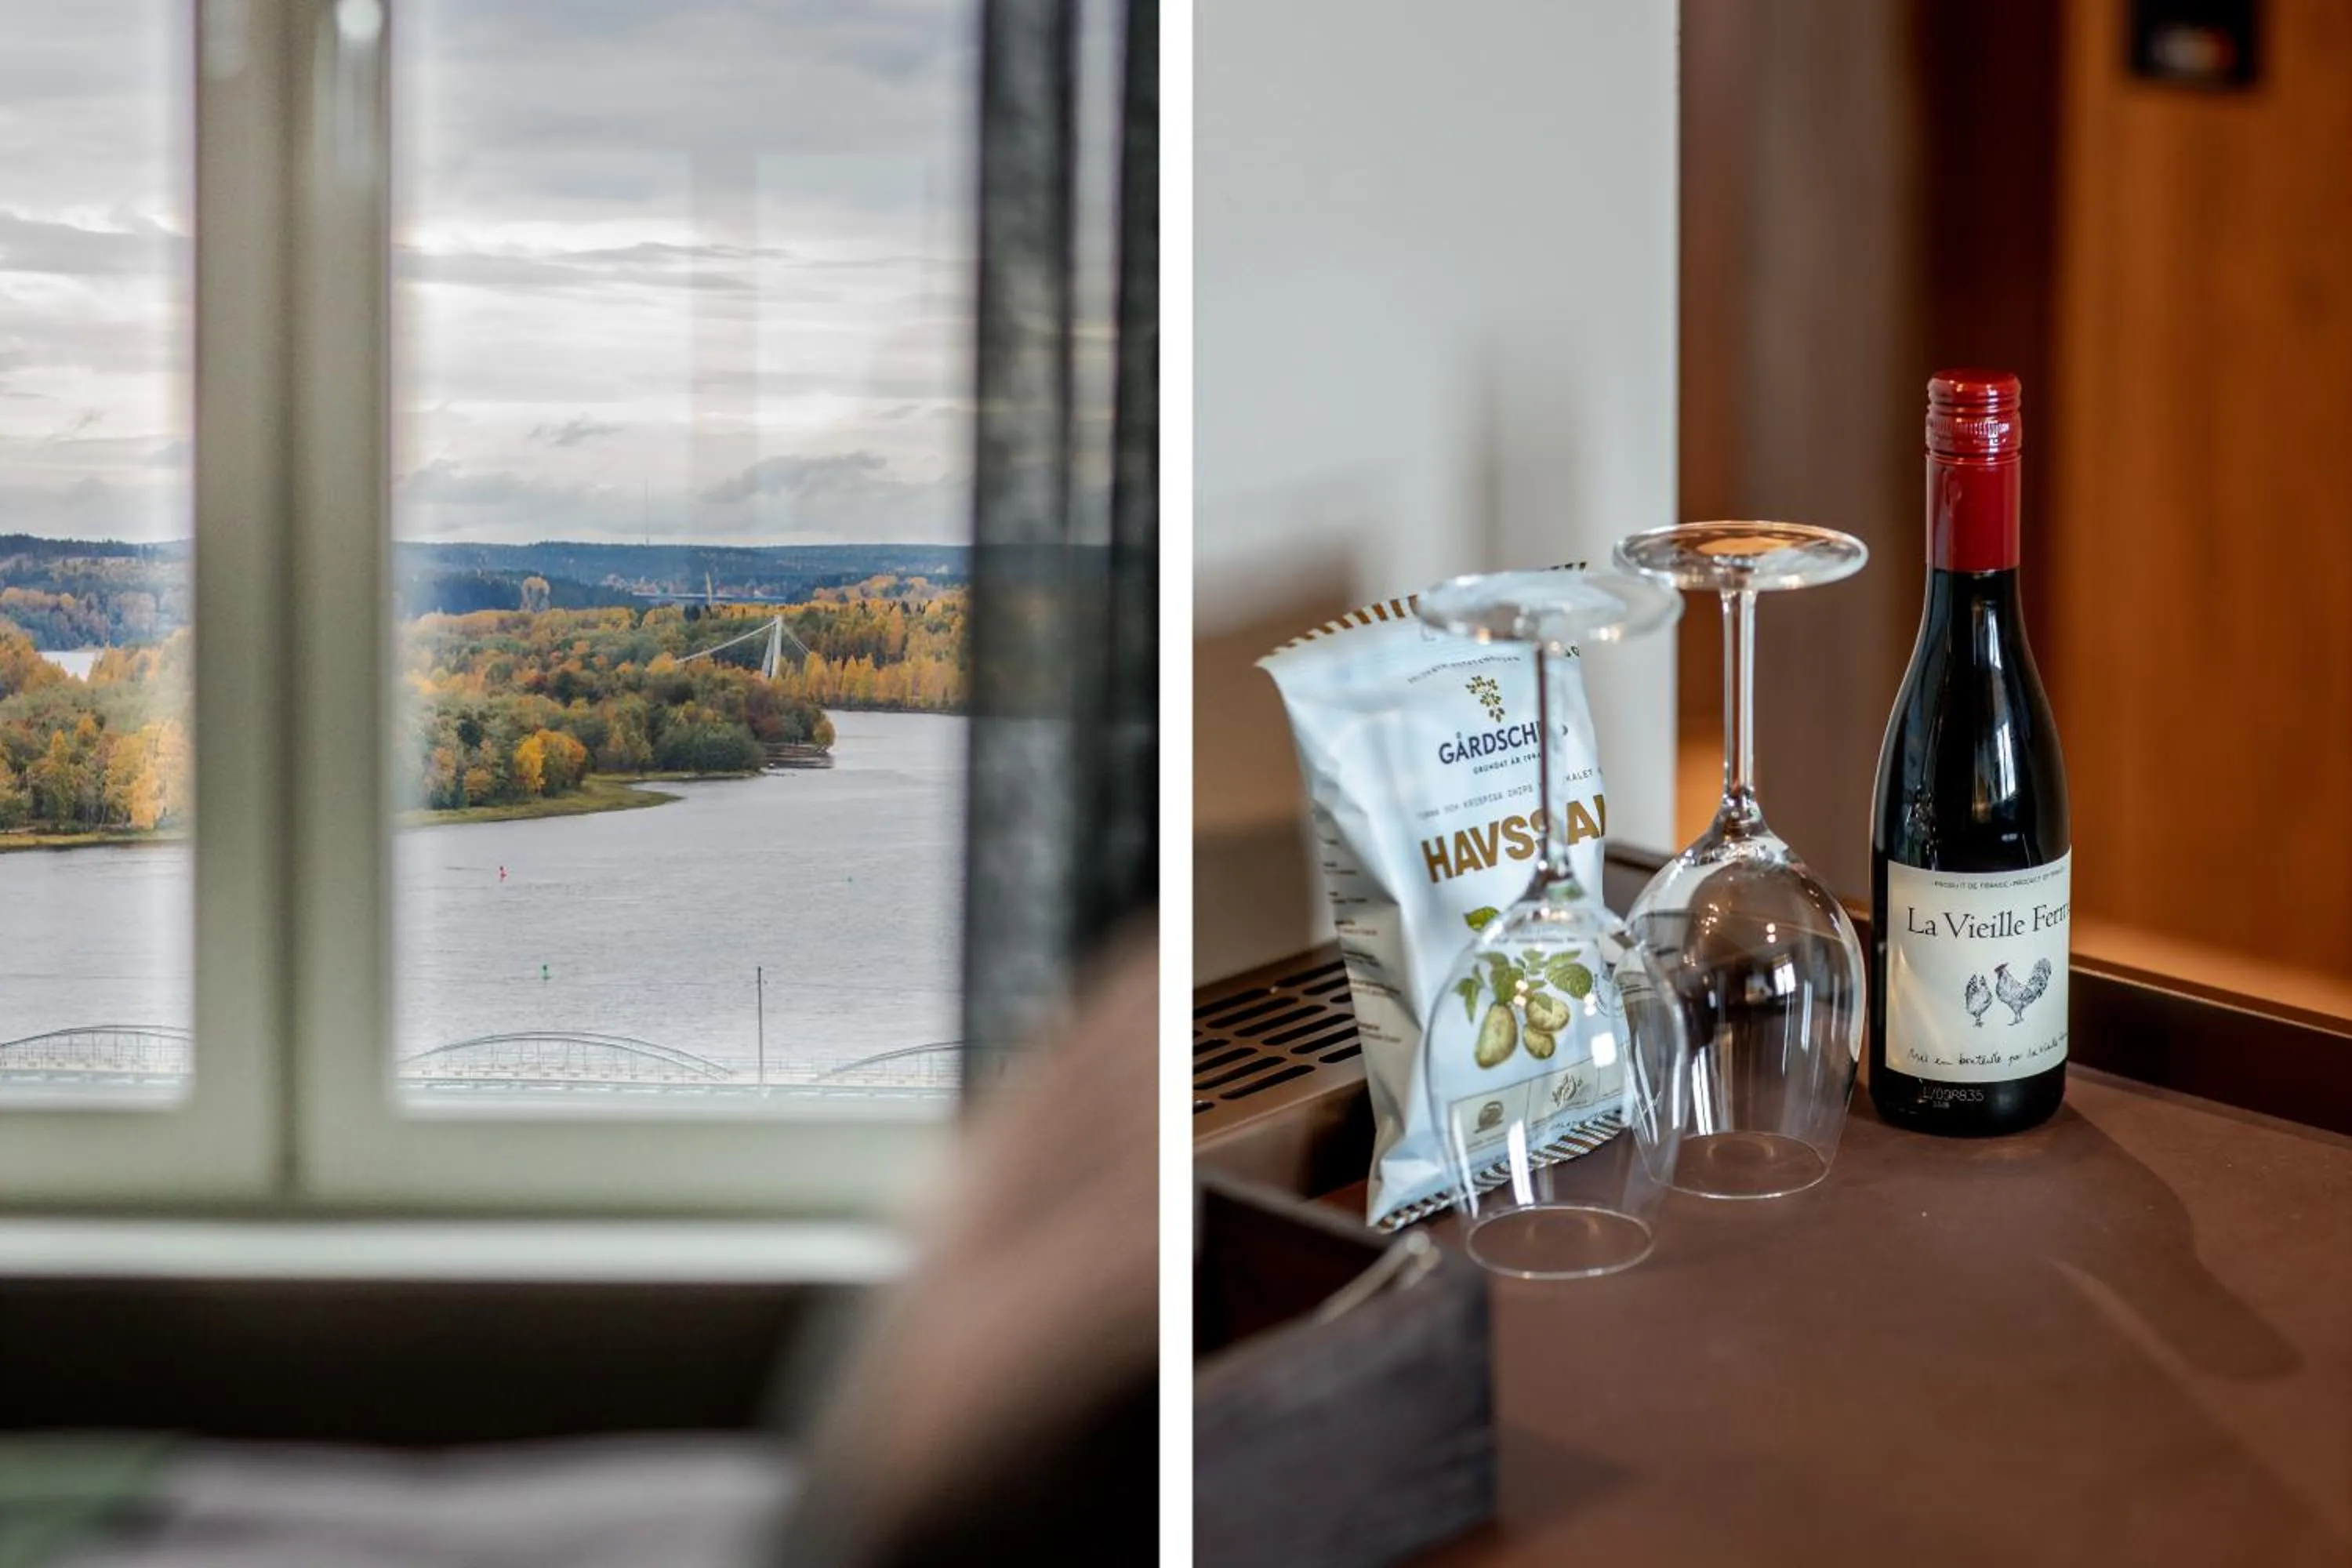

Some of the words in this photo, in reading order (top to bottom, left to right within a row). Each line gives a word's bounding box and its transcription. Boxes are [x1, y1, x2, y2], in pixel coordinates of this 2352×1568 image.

[1439, 720, 1568, 764] GÅRDSCHI
[1907, 906, 1938, 936] La
[1943, 910, 2026, 938] Vieille
[2032, 903, 2069, 931] Ferm
